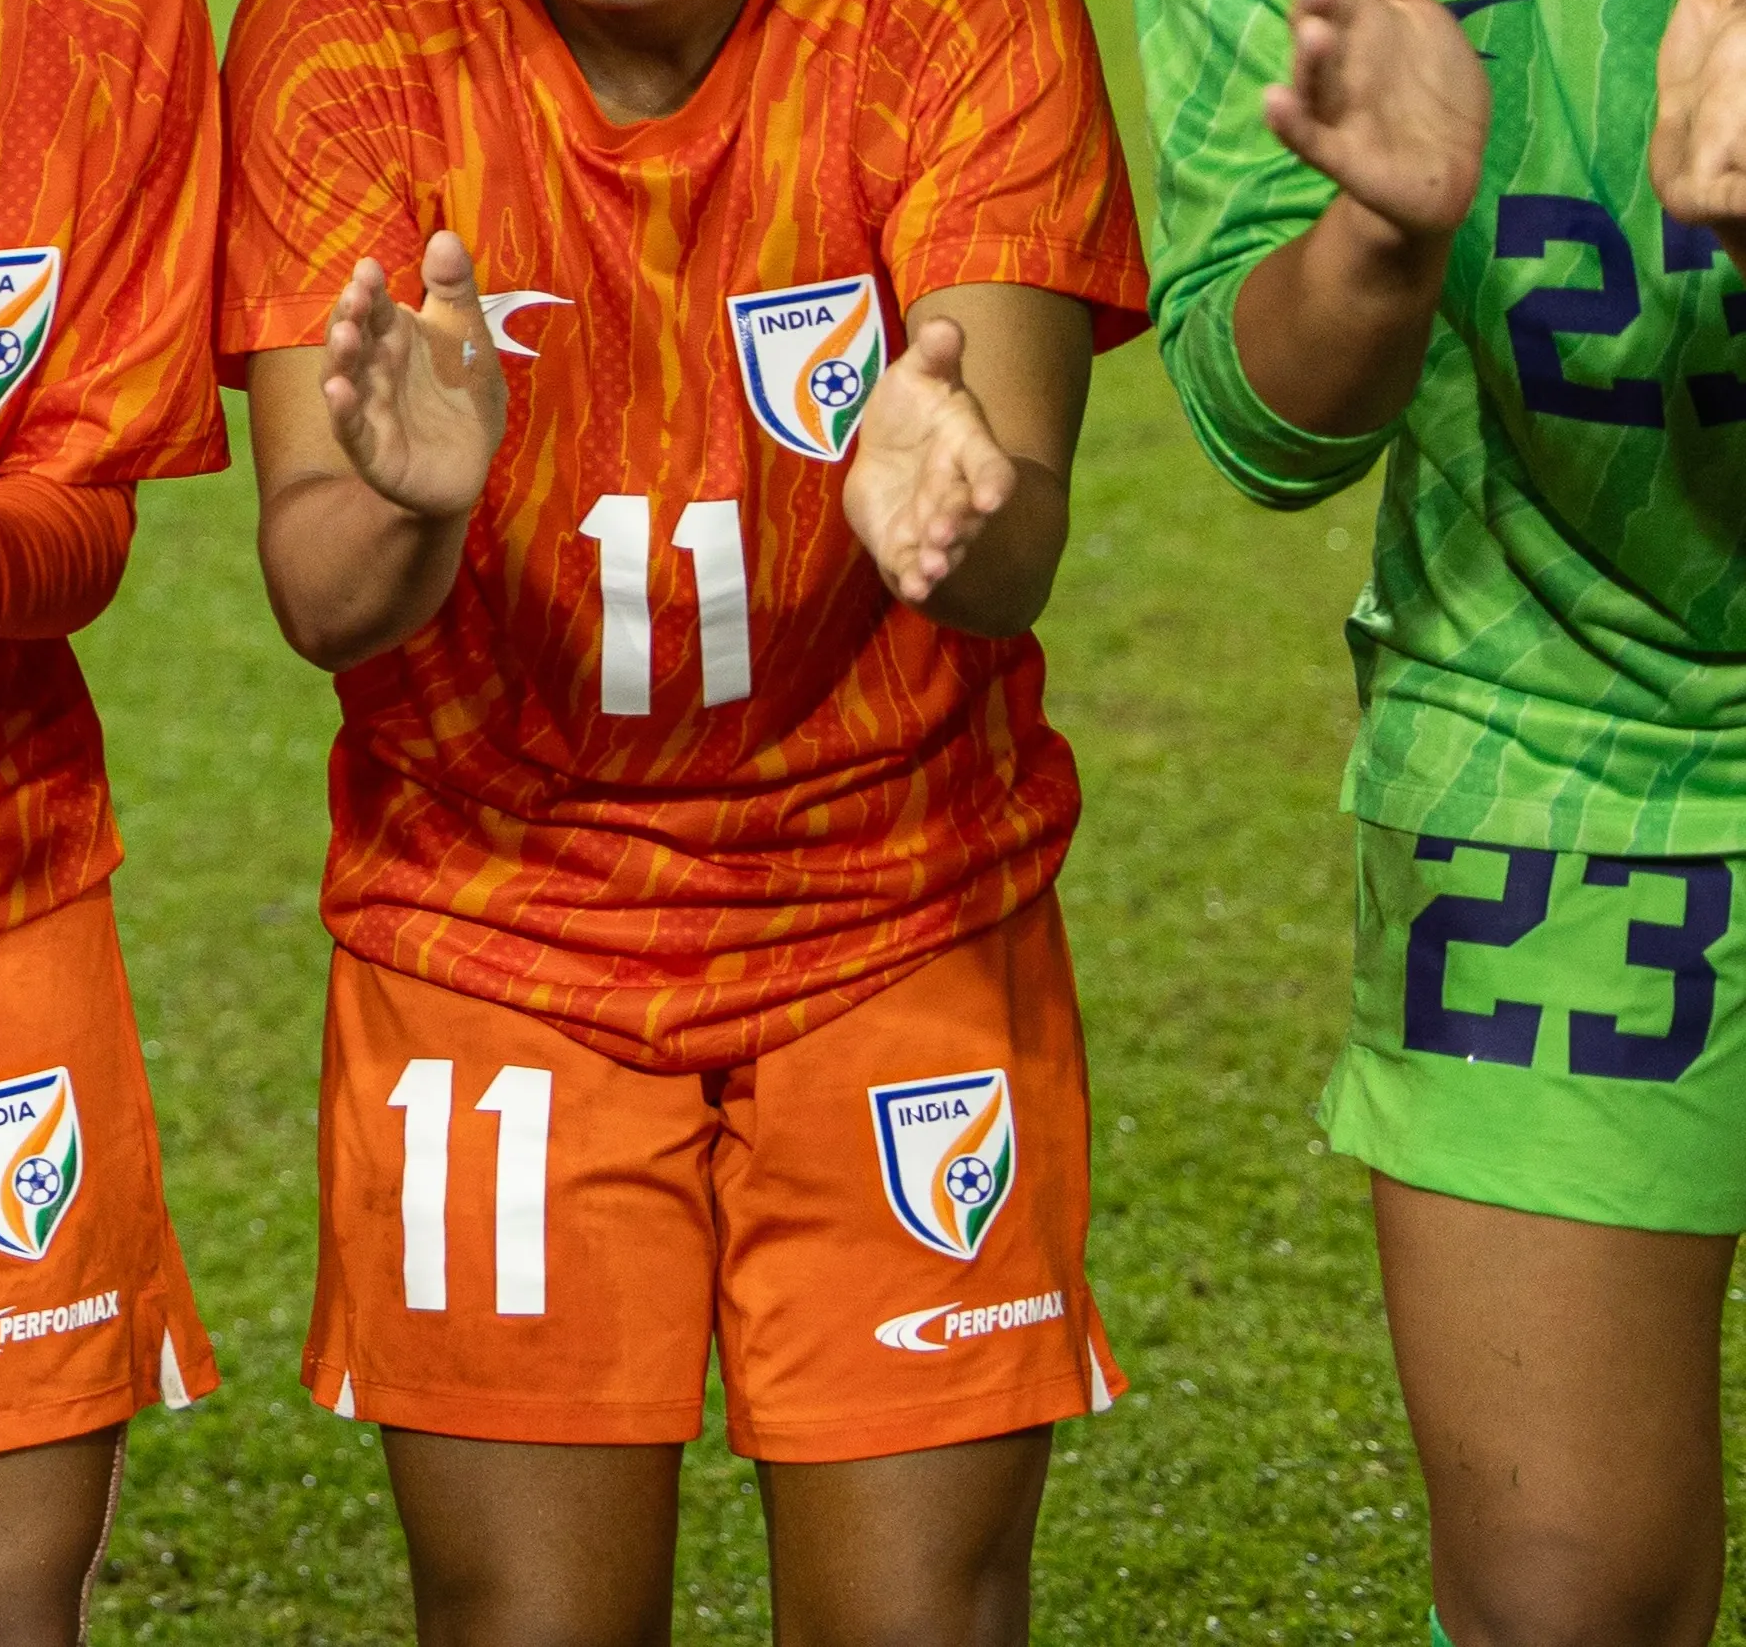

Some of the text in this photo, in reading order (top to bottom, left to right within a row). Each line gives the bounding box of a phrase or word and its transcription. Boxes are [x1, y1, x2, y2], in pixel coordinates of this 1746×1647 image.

[758, 305, 835, 335] INDIA
[578, 494, 752, 715] 11
[1403, 835, 1733, 1083] 23
[898, 1098, 970, 1126] INDIA
[386, 1058, 553, 1315] 11
[944, 1290, 1065, 1341] PERFORMAX
